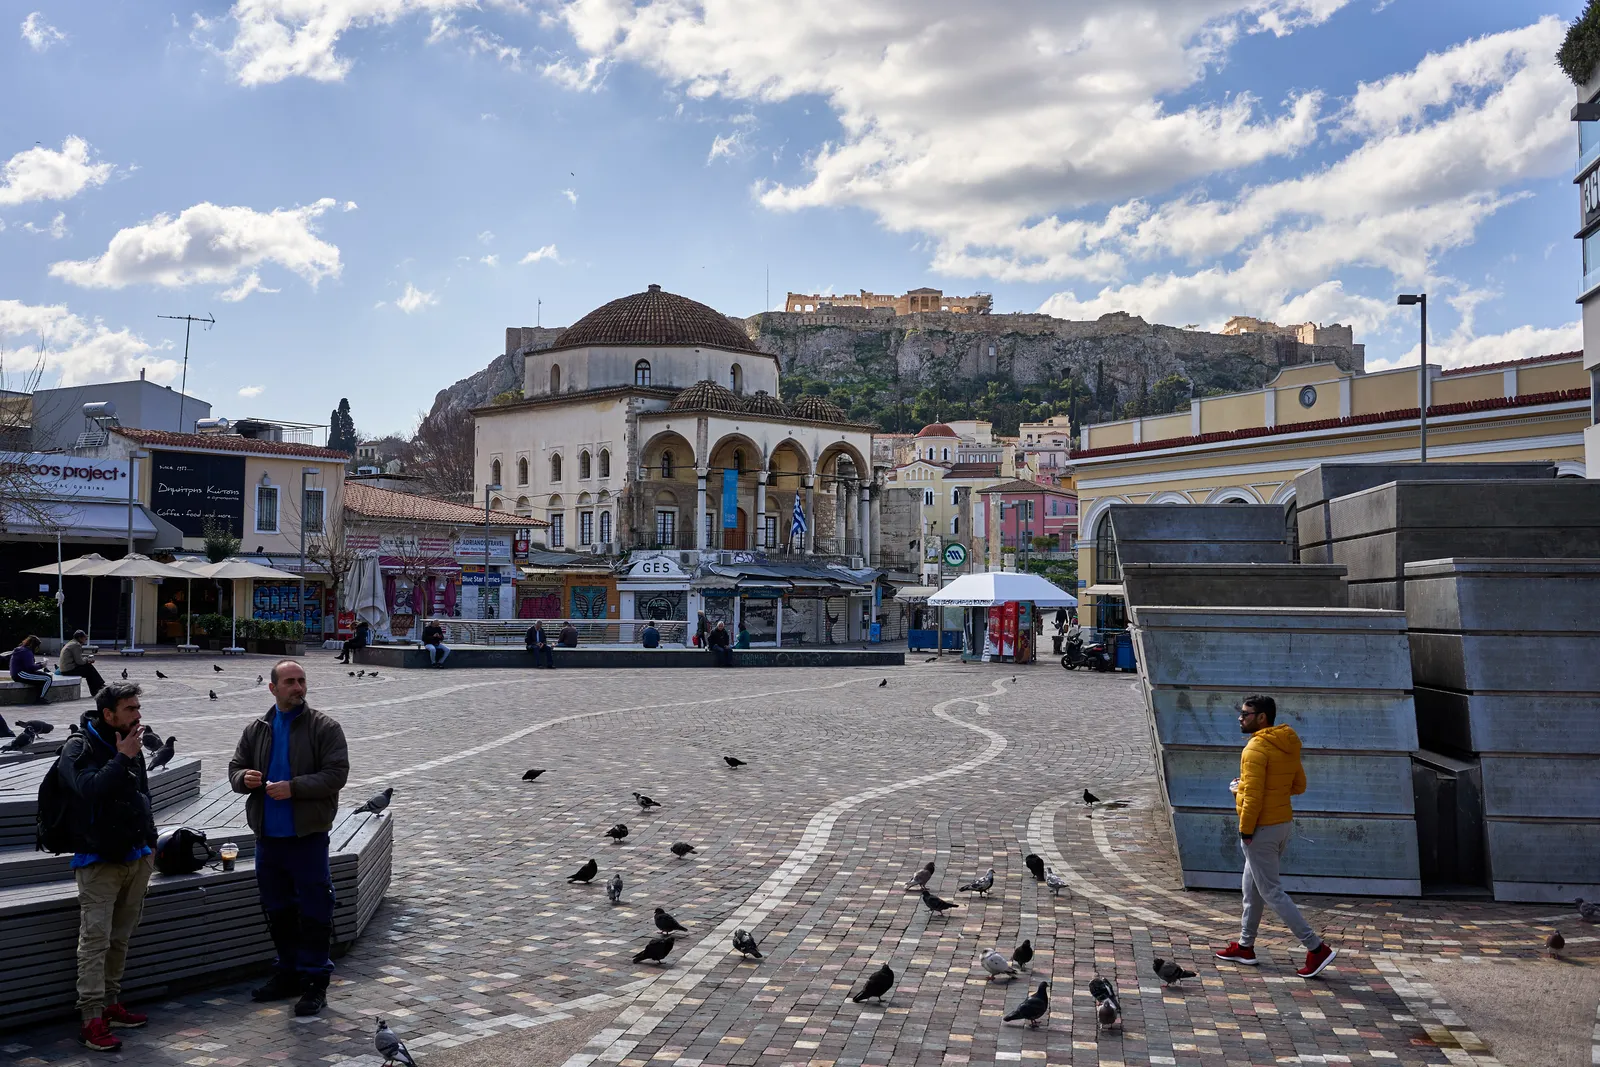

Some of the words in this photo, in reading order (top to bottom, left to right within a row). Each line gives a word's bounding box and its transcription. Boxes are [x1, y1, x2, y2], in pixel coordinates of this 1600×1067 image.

[63, 465, 119, 482] project
[157, 508, 180, 516] Coffee
[186, 509, 202, 517] food
[642, 562, 670, 573] GES
